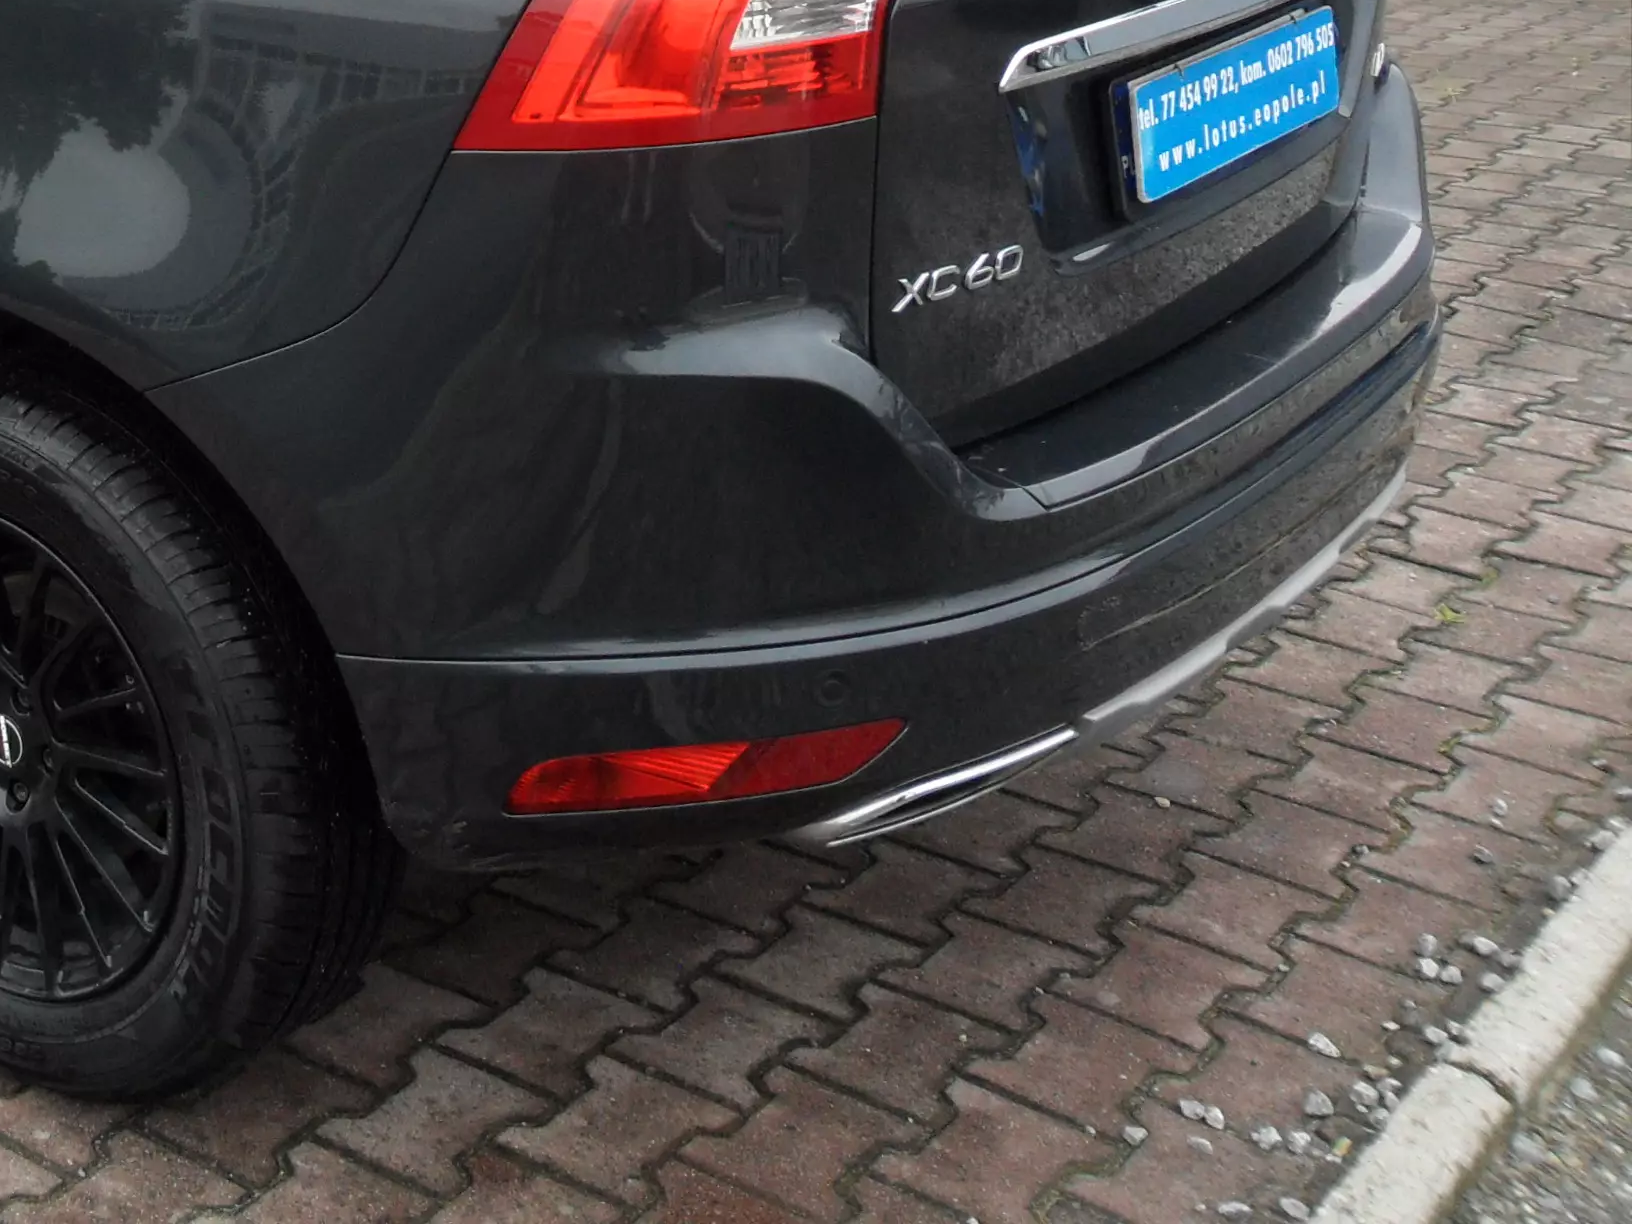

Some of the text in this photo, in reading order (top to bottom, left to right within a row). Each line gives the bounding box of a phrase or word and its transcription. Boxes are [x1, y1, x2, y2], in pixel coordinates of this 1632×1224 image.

[1137, 22, 1336, 130] tel. 77 454 99 22, kom. 0602 796 505
[1158, 70, 1326, 172] www.lotus.eopole.pl
[891, 244, 1024, 313] XC60
